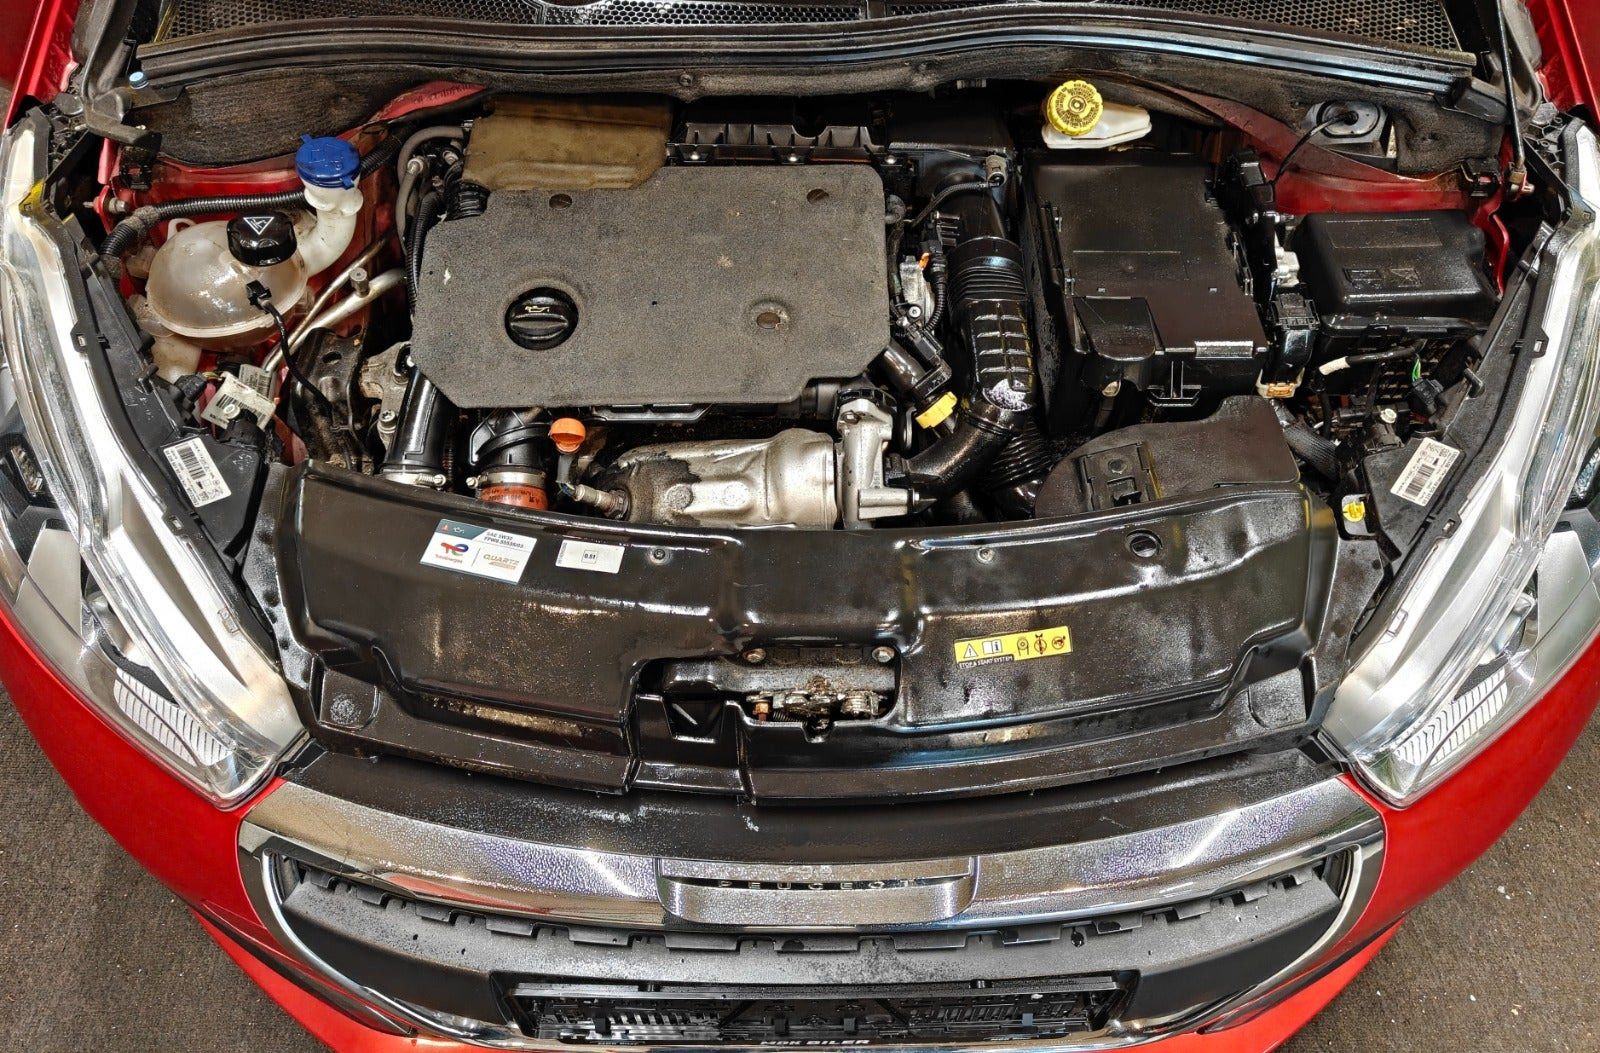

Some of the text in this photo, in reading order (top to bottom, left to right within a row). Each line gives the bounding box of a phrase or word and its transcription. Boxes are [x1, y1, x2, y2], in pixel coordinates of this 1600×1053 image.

[498, 533, 513, 541] 5W30
[483, 553, 520, 566] QUARTZ
[978, 658, 993, 666] START
[994, 655, 1013, 664] SYSTEM
